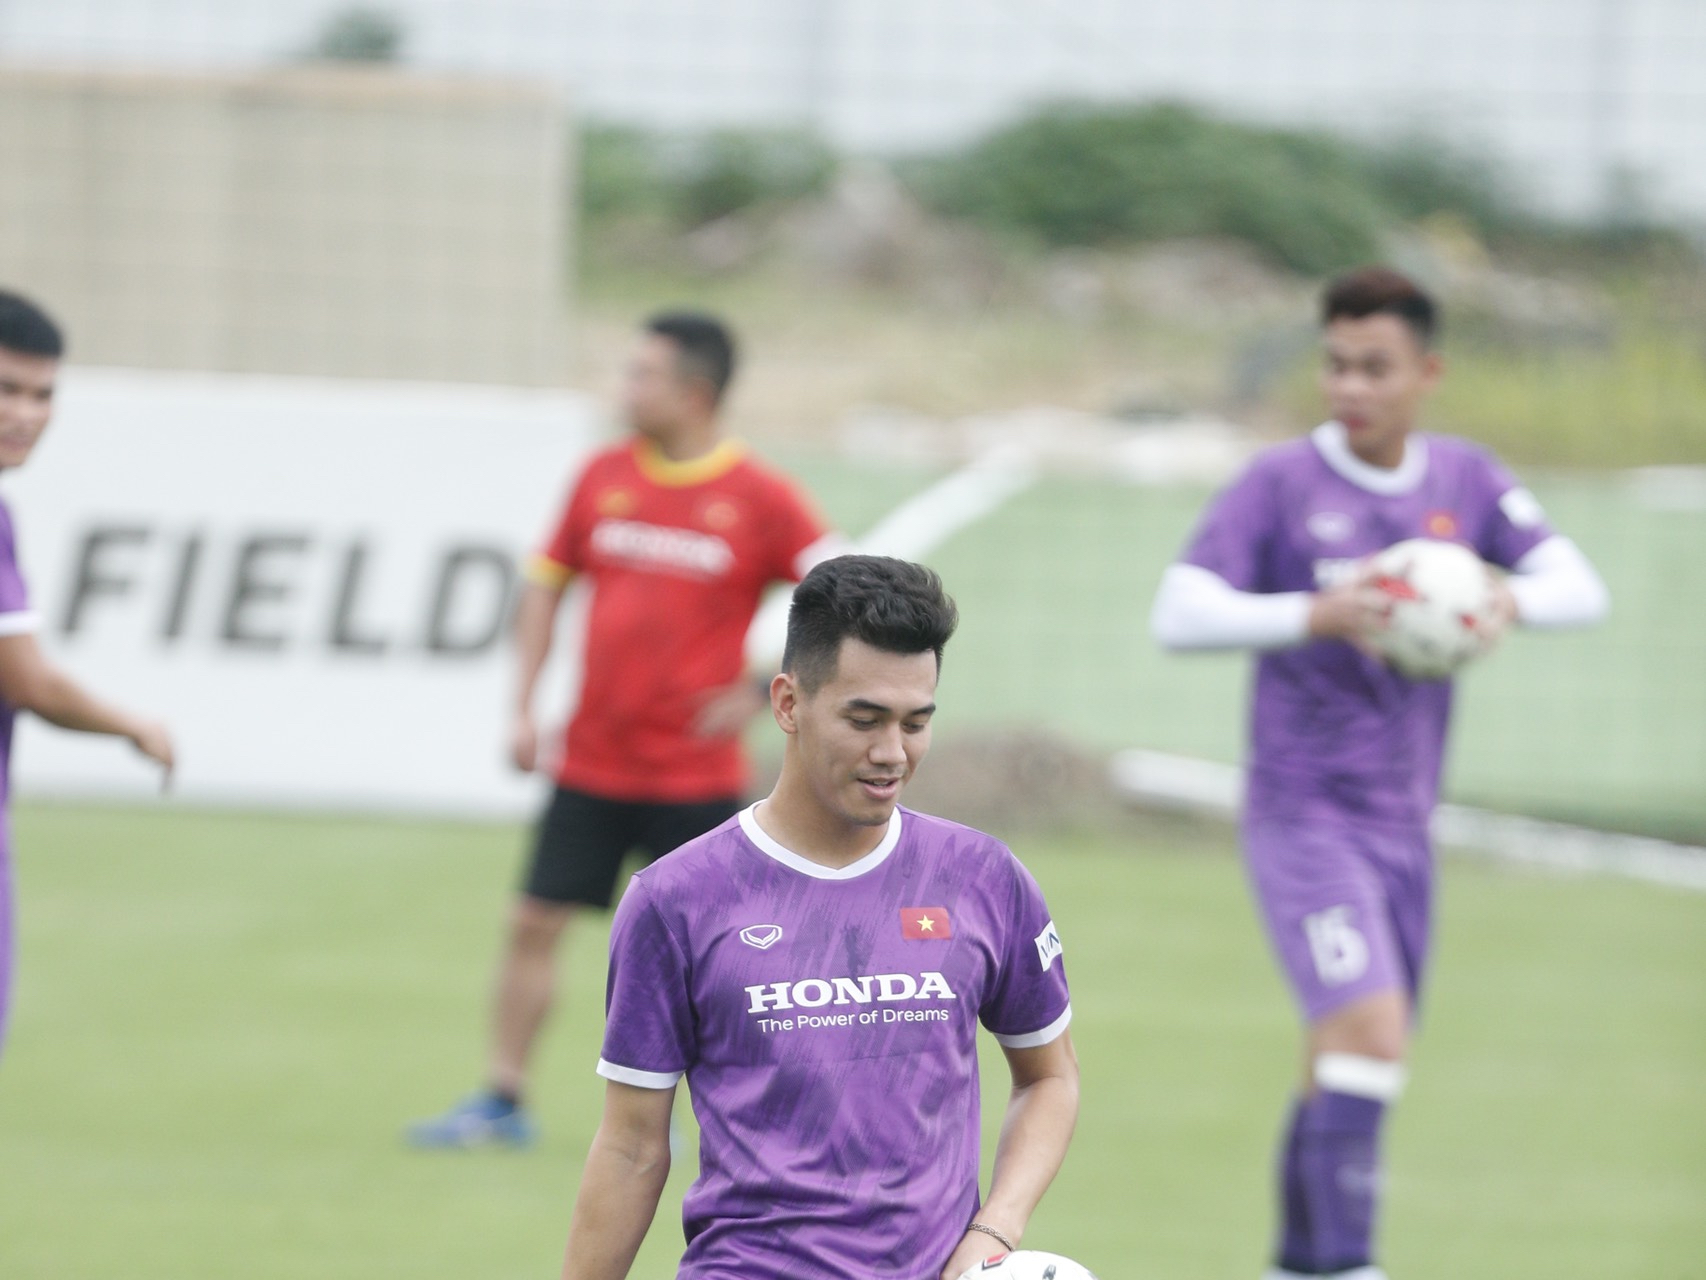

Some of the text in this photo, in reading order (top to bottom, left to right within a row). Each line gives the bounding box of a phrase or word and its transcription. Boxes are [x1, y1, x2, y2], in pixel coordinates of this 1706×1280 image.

[57, 527, 523, 658] FIELD
[744, 971, 957, 1014] HONDA
[757, 1008, 949, 1033] The Power of Dreams
